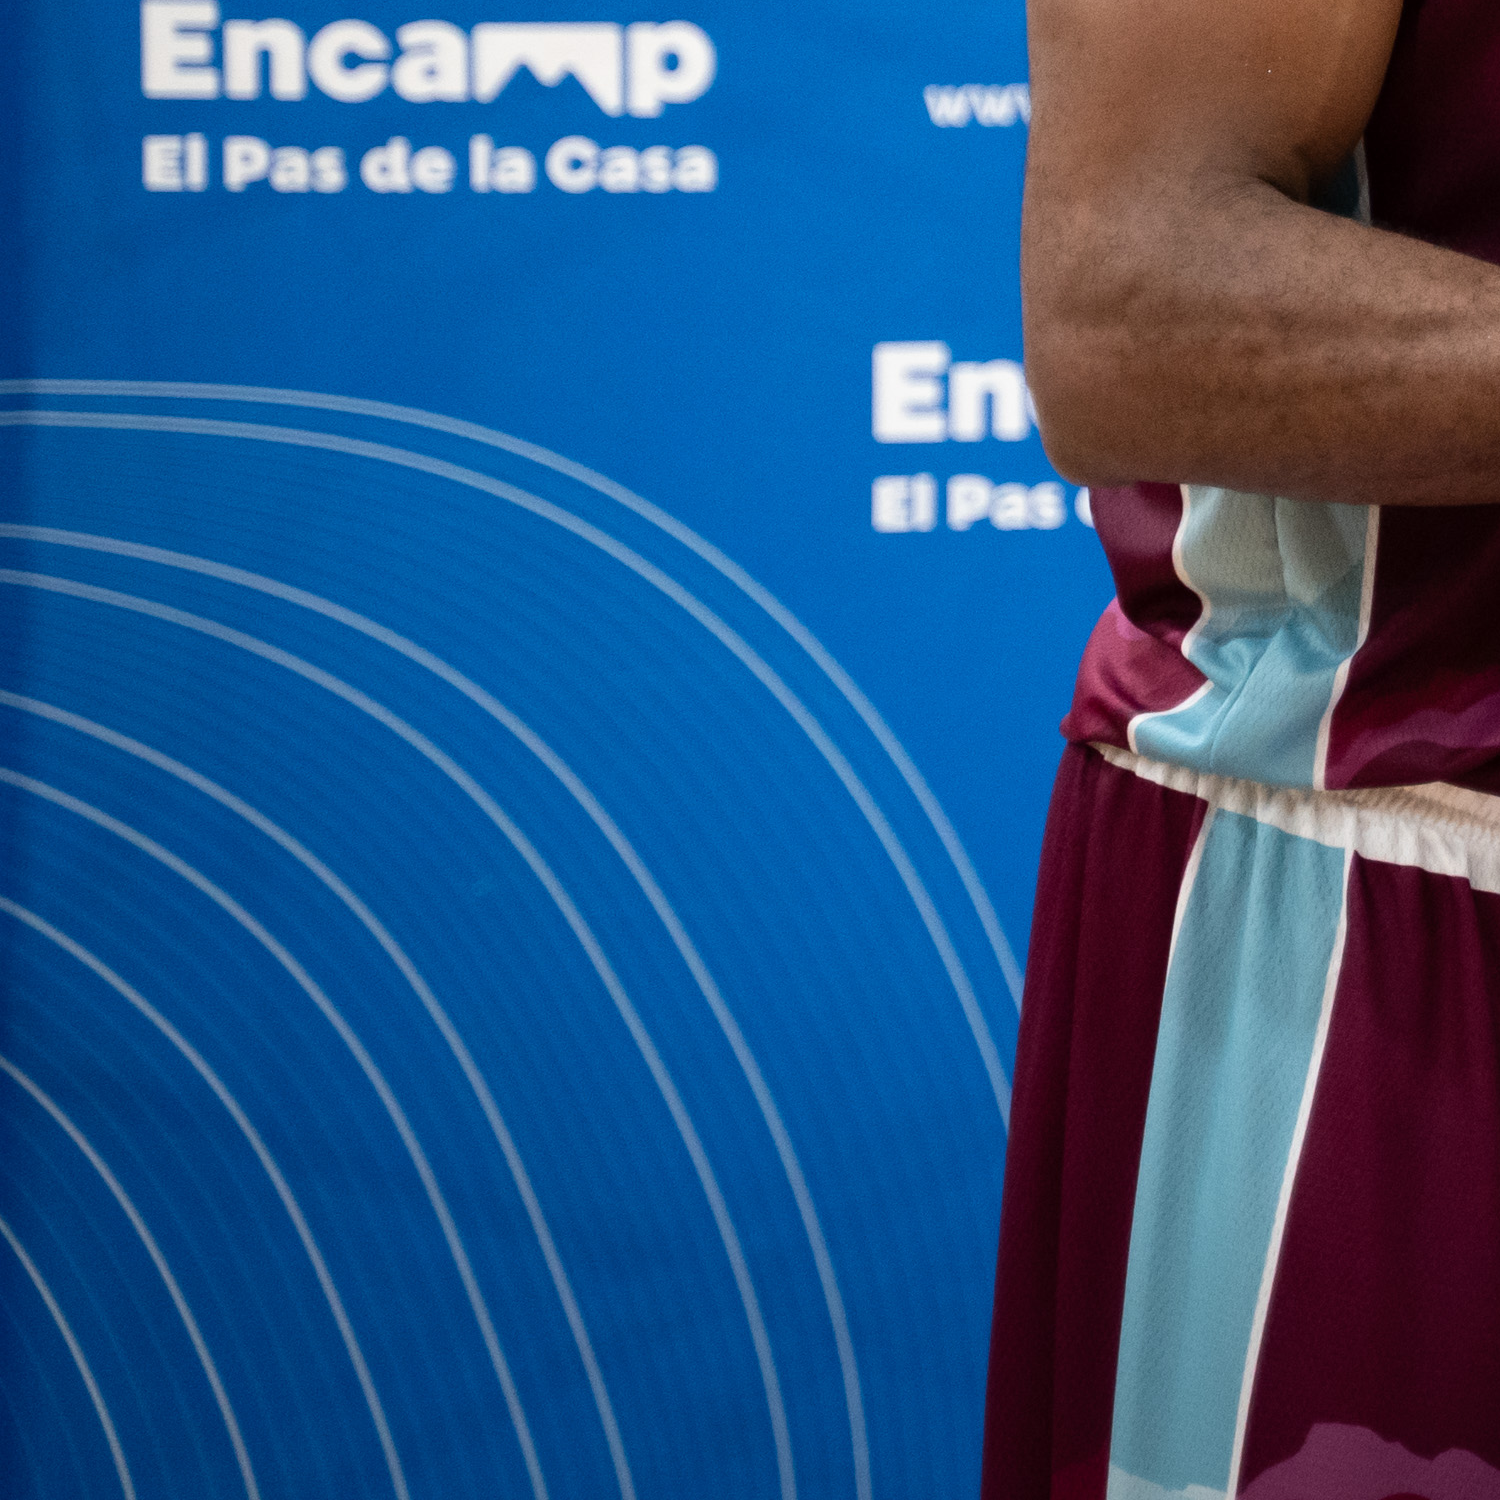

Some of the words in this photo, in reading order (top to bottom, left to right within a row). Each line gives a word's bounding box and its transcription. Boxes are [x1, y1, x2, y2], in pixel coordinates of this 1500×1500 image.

[143, 133, 207, 191] El
[223, 136, 346, 193] Pas
[361, 137, 455, 193] de
[469, 134, 535, 193] la
[546, 136, 717, 193] Casa
[871, 473, 937, 533] El
[946, 474, 1067, 532] Pas
